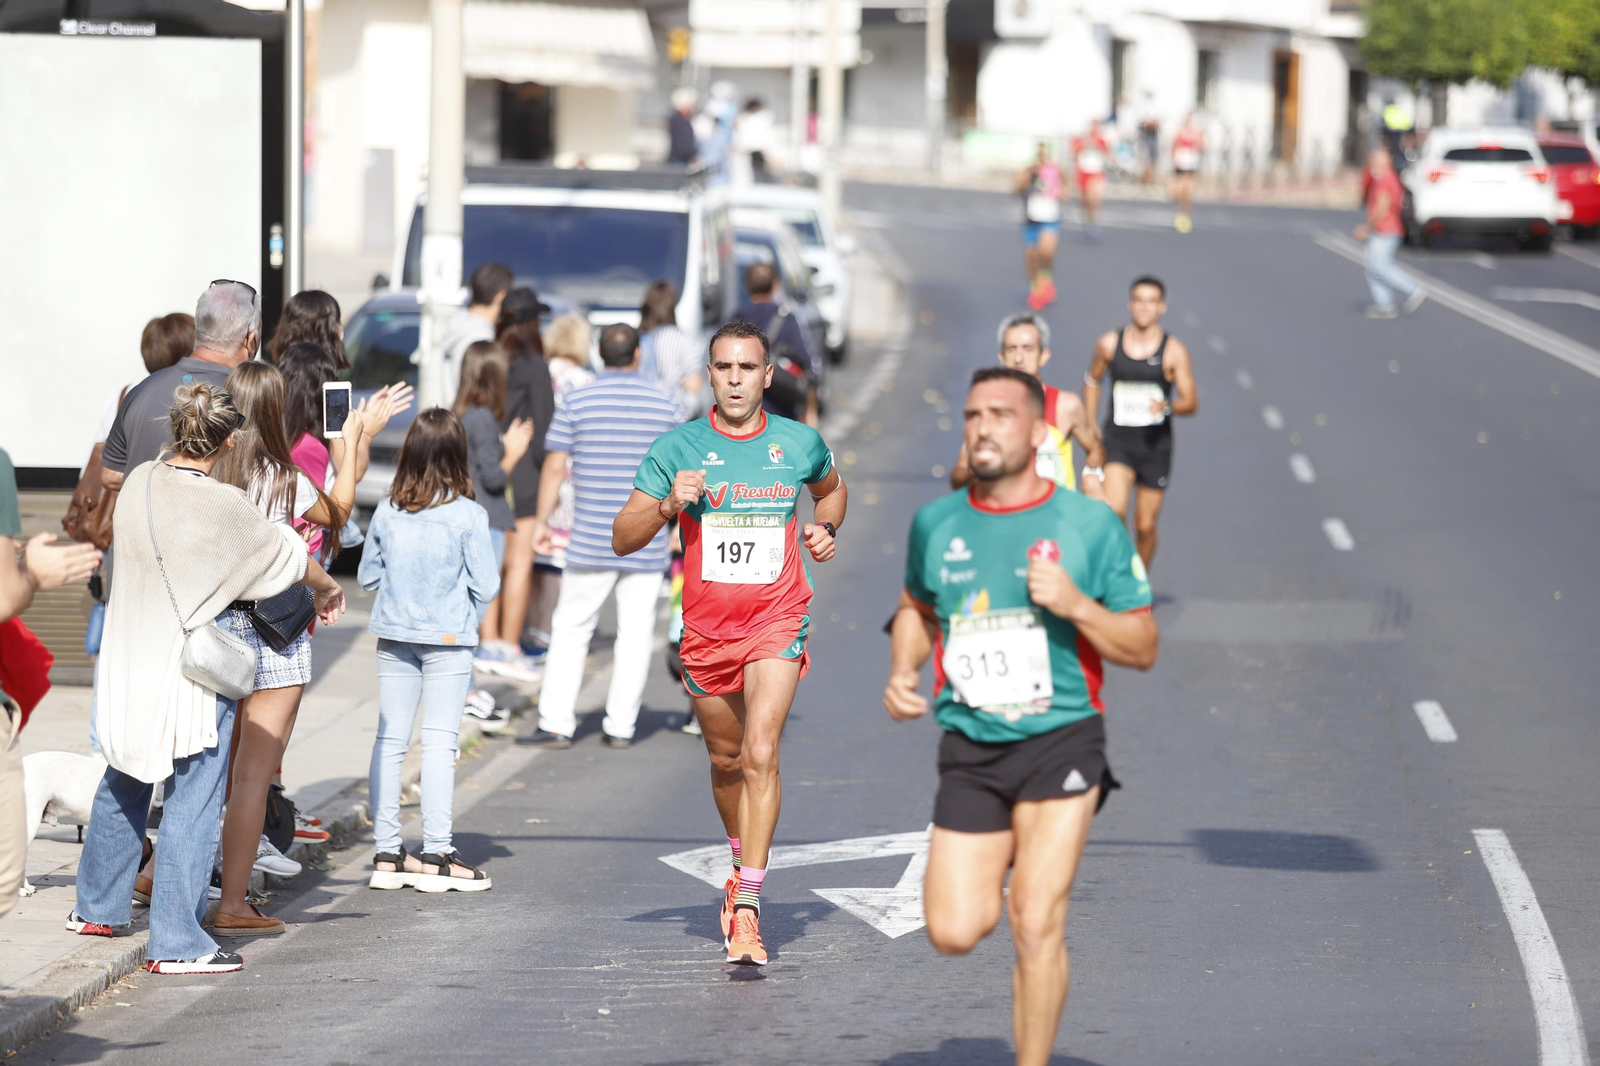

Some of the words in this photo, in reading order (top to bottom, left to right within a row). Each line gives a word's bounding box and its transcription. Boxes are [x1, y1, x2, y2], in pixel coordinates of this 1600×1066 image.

[78, 20, 107, 34] Clear
[108, 21, 156, 36] Channel
[731, 481, 796, 502] Fresaflor
[718, 516, 744, 527] VUELTA
[745, 516, 751, 526] A
[717, 541, 755, 564] 197
[958, 649, 1009, 681] 313
